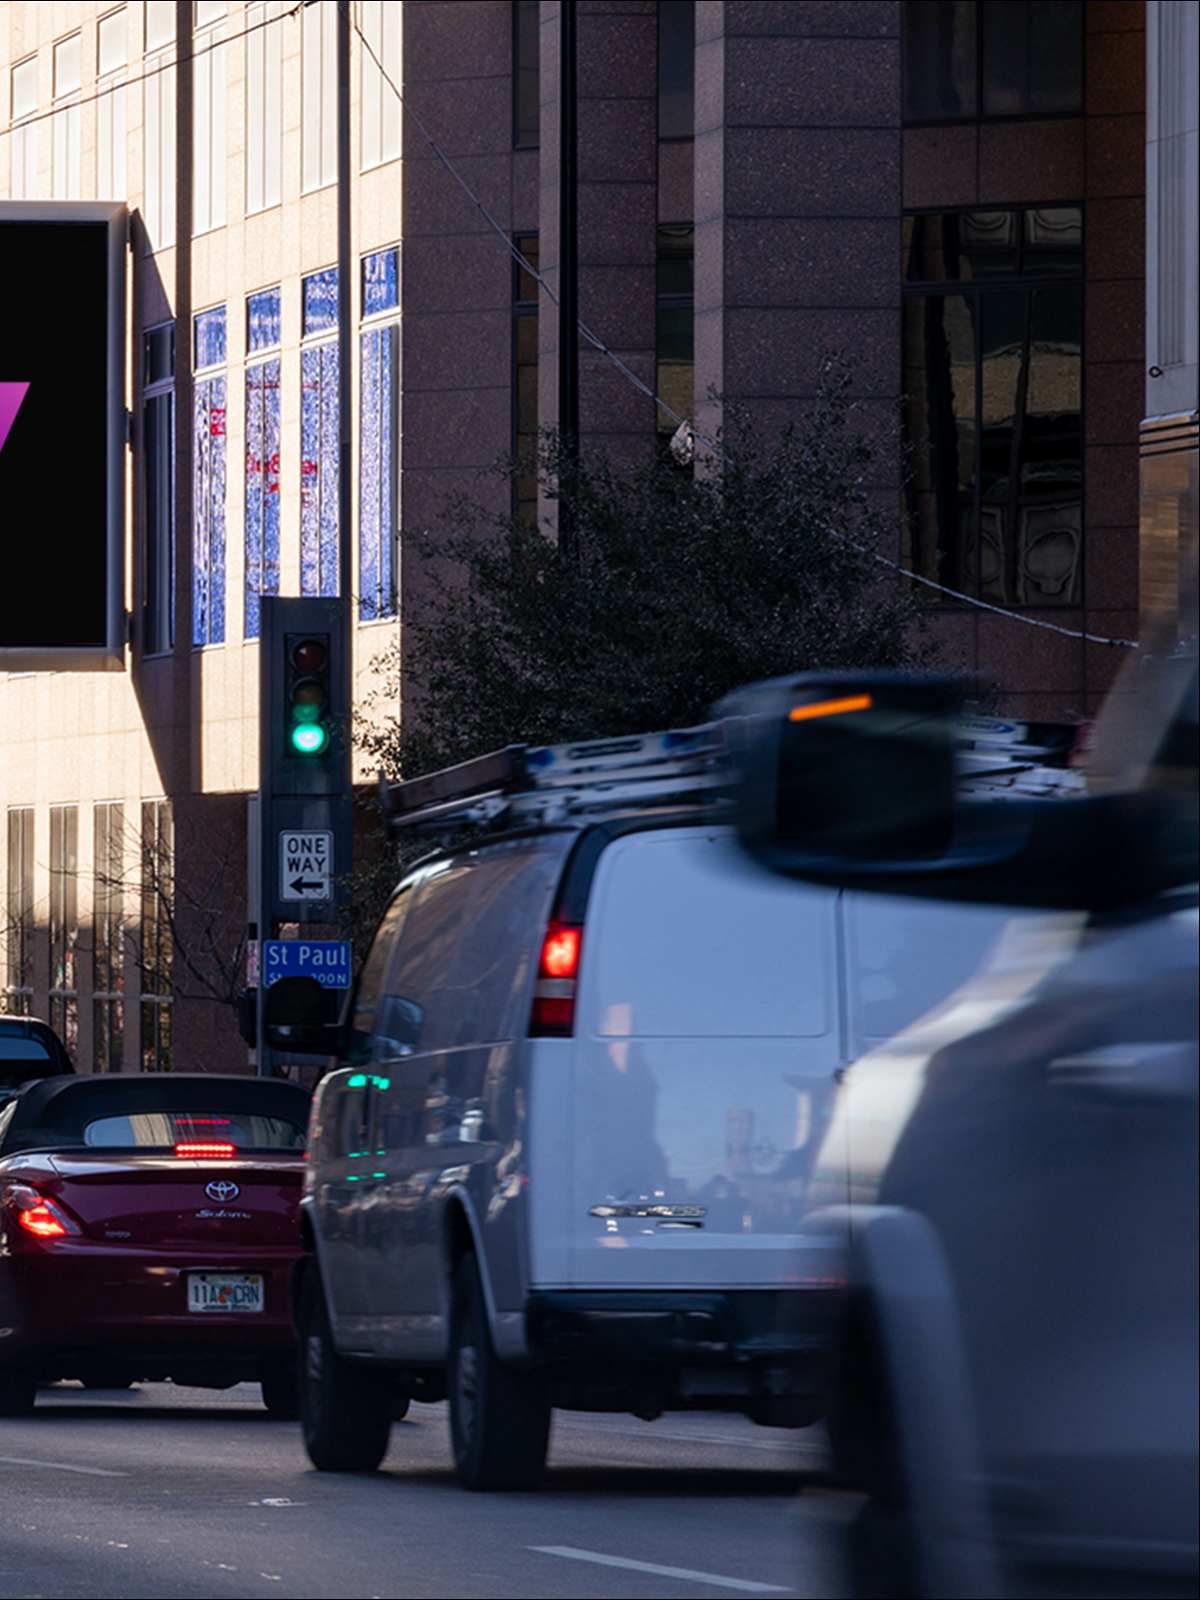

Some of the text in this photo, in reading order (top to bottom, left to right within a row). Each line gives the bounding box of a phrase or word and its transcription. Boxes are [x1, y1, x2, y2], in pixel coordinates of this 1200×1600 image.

[287, 838, 326, 854] ONE
[287, 857, 327, 872] WAY
[269, 945, 346, 966] St Paul
[194, 1285, 217, 1303] 11A
